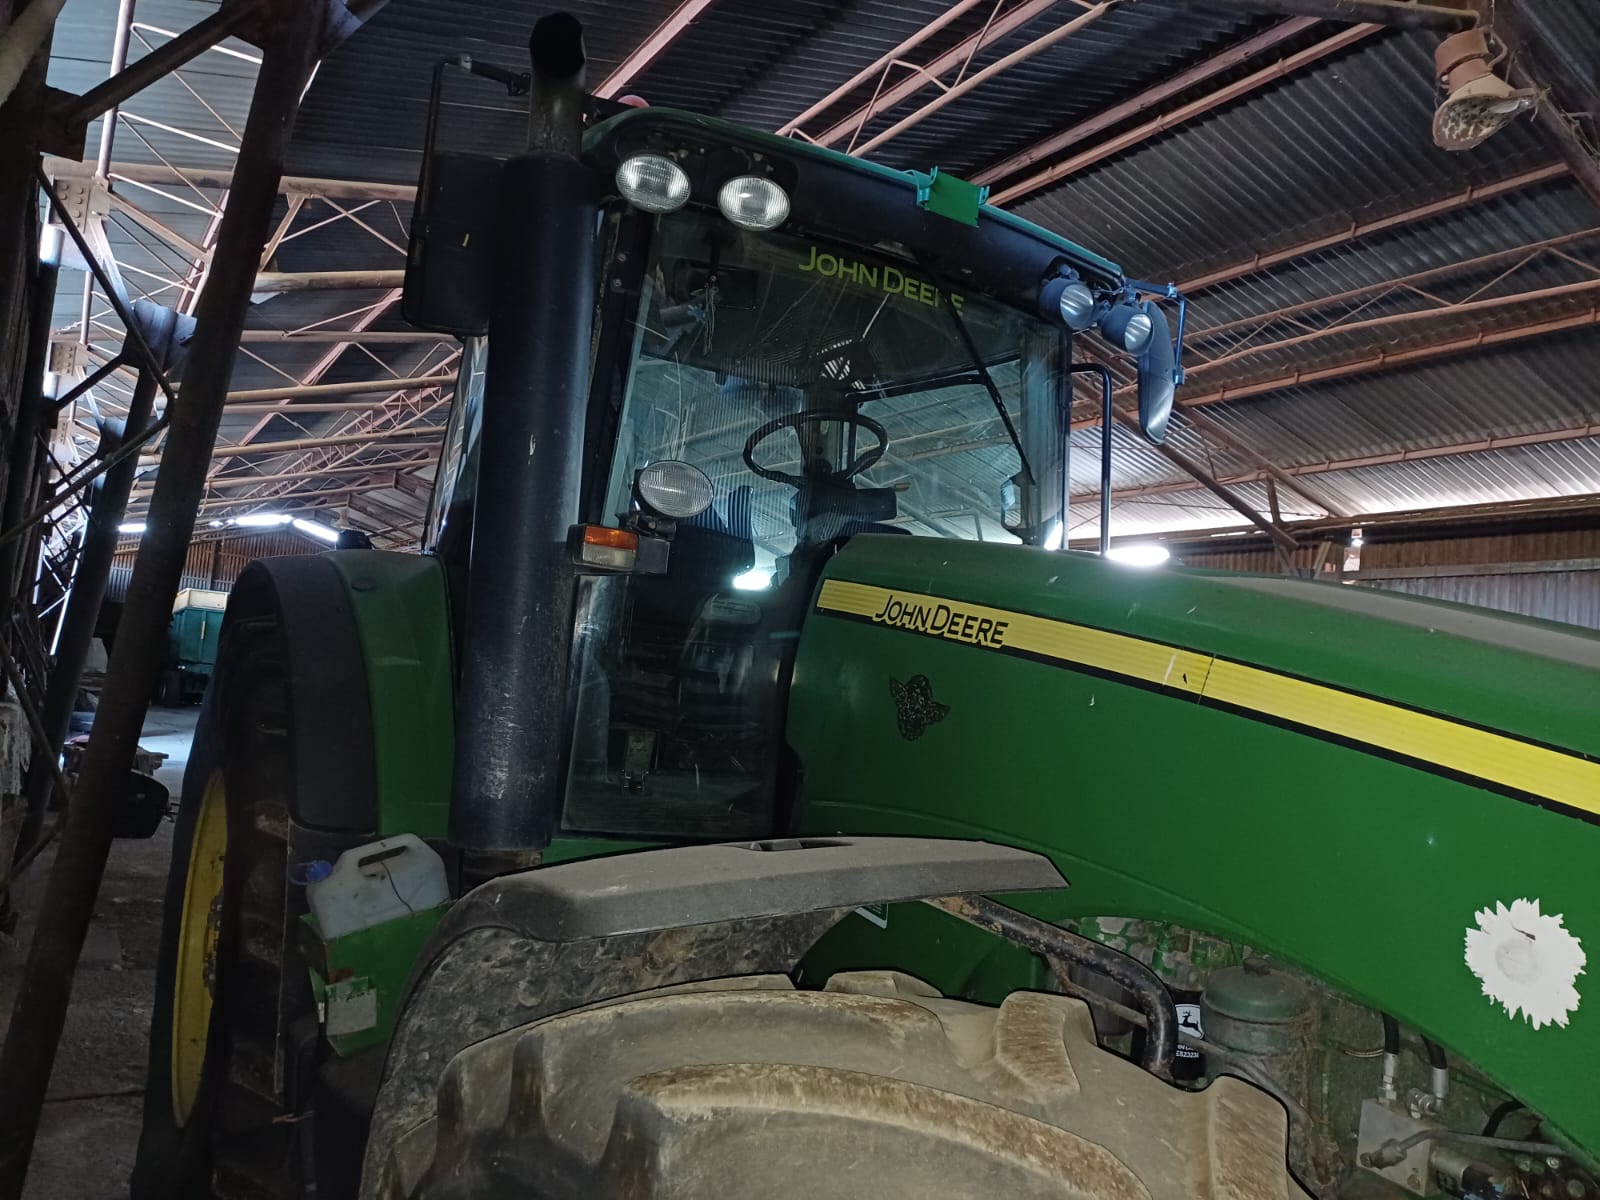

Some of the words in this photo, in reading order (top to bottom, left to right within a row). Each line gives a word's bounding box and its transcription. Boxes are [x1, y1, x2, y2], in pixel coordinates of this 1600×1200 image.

[799, 246, 878, 288] JOHN
[875, 595, 932, 629] JOHN
[930, 604, 1009, 645] DEERE
